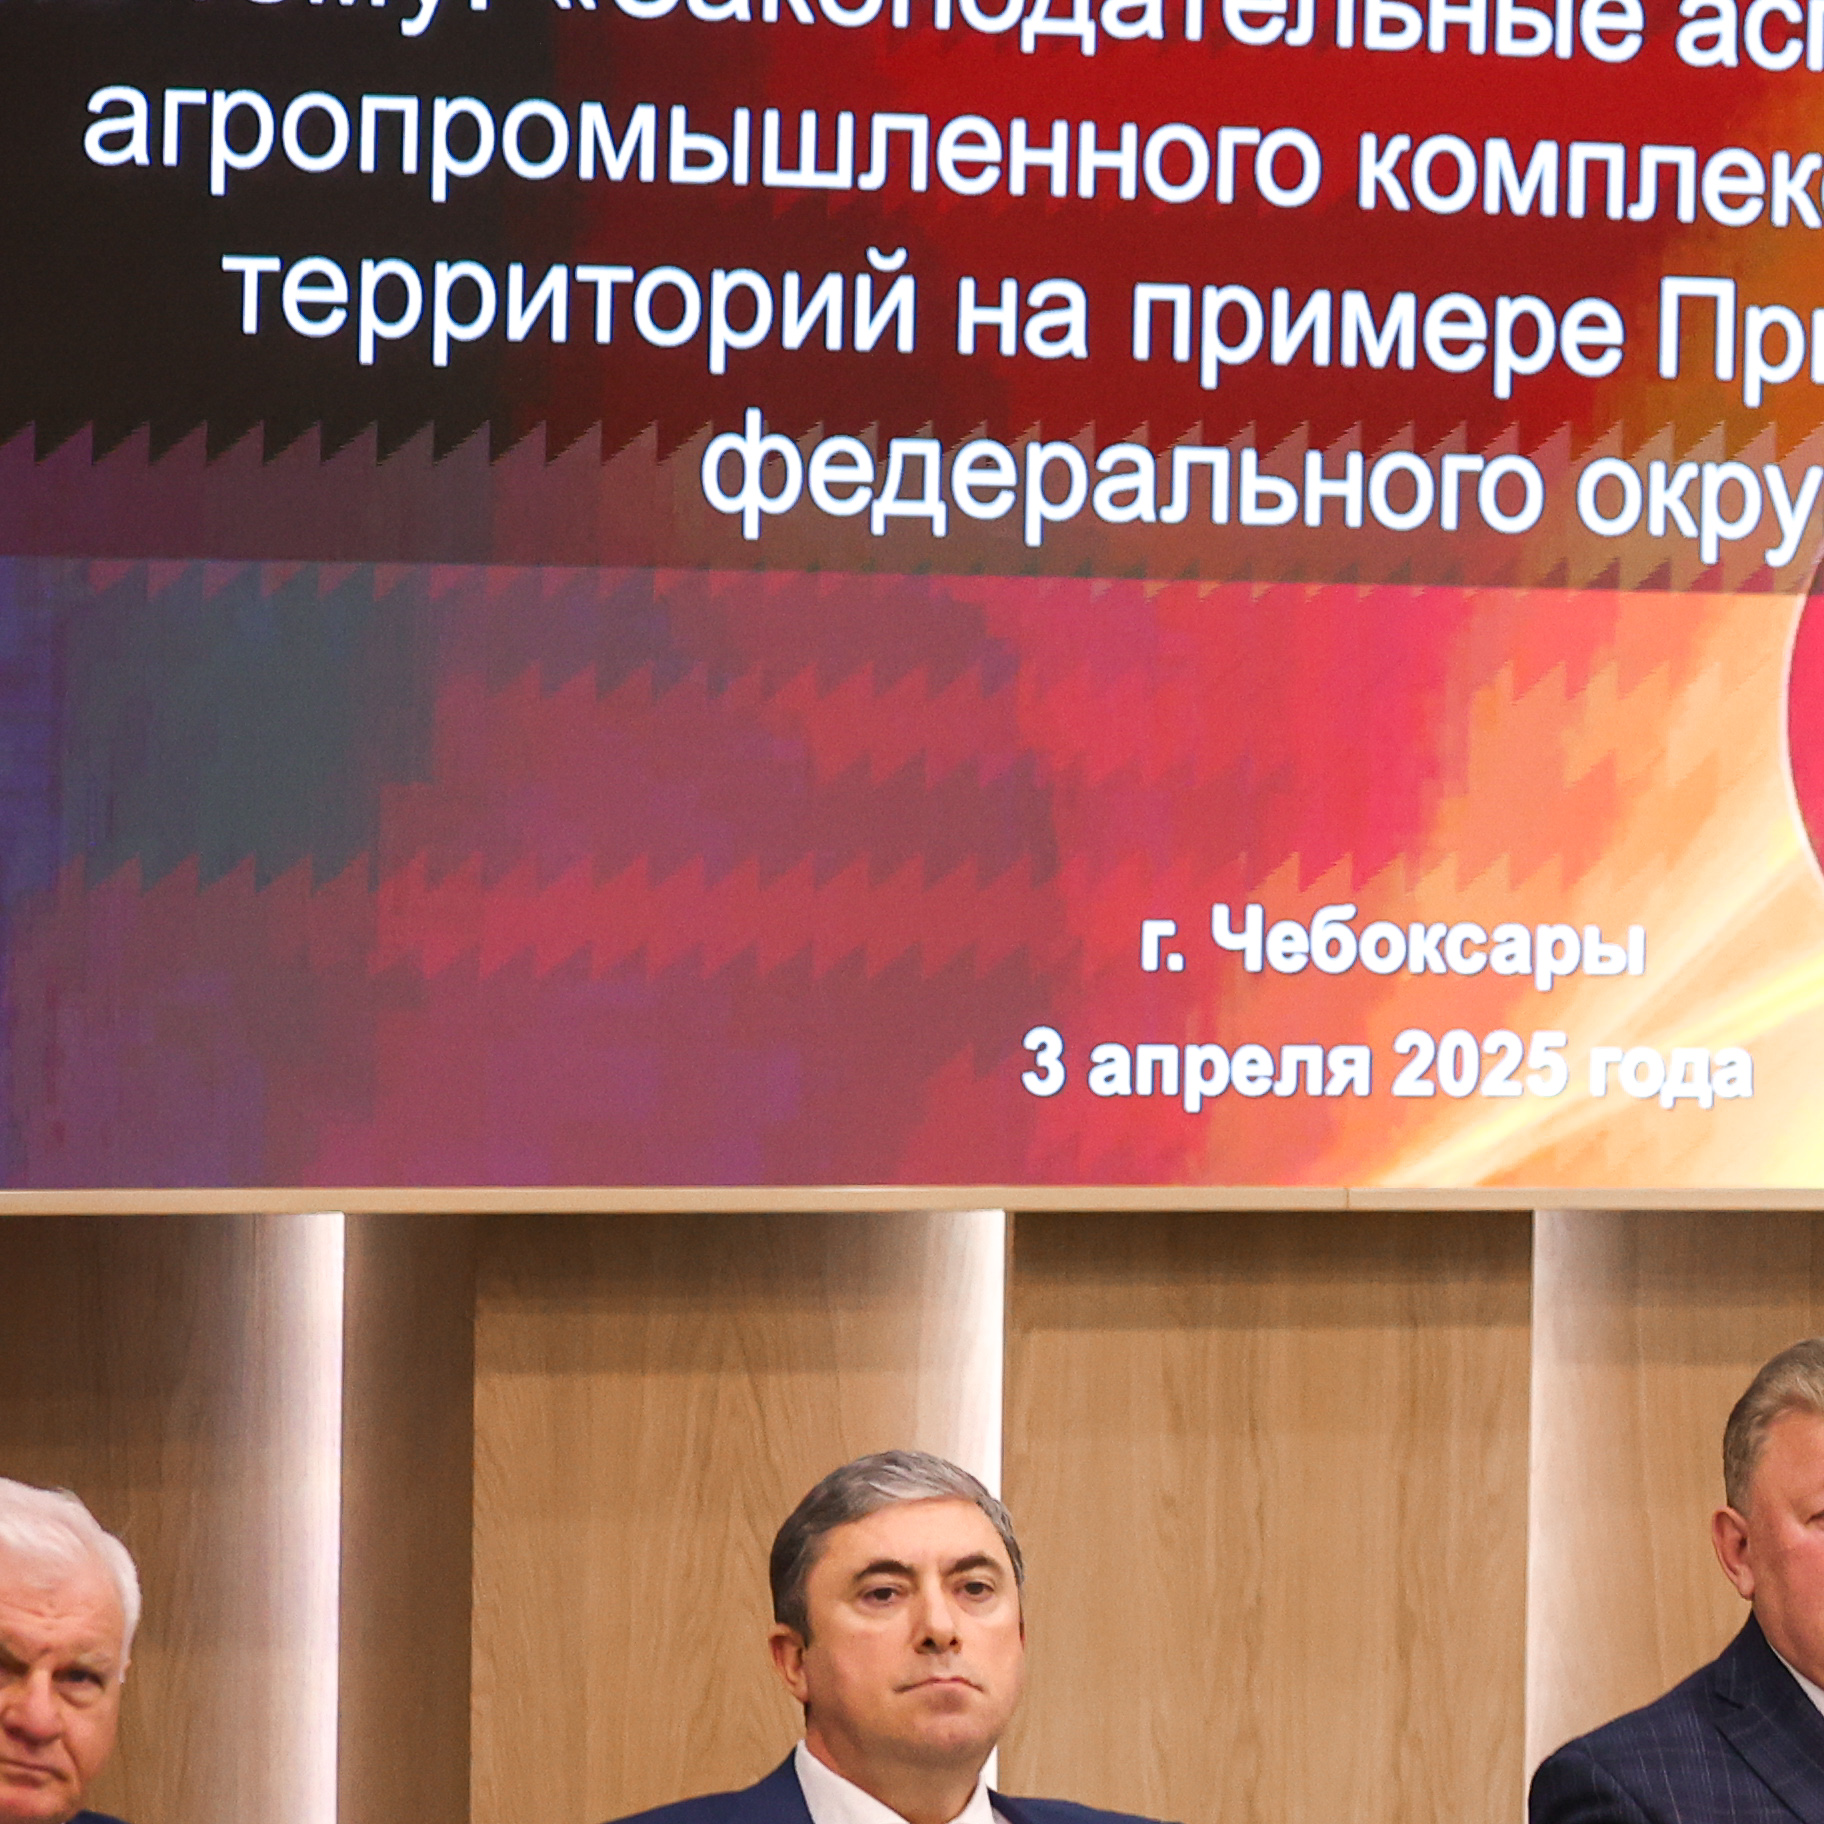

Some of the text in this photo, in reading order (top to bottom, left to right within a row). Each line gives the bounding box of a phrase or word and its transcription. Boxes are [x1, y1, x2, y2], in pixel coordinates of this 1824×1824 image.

[83, 84, 1323, 208] агропромышленного
[221, 246, 916, 375] территорий
[957, 276, 1089, 360] на
[1132, 281, 1625, 400] примере
[701, 406, 1546, 547] федерального
[1140, 902, 1647, 992] г. Чебоксары
[1021, 1025, 1755, 1113] 3 апреля 2025 года
